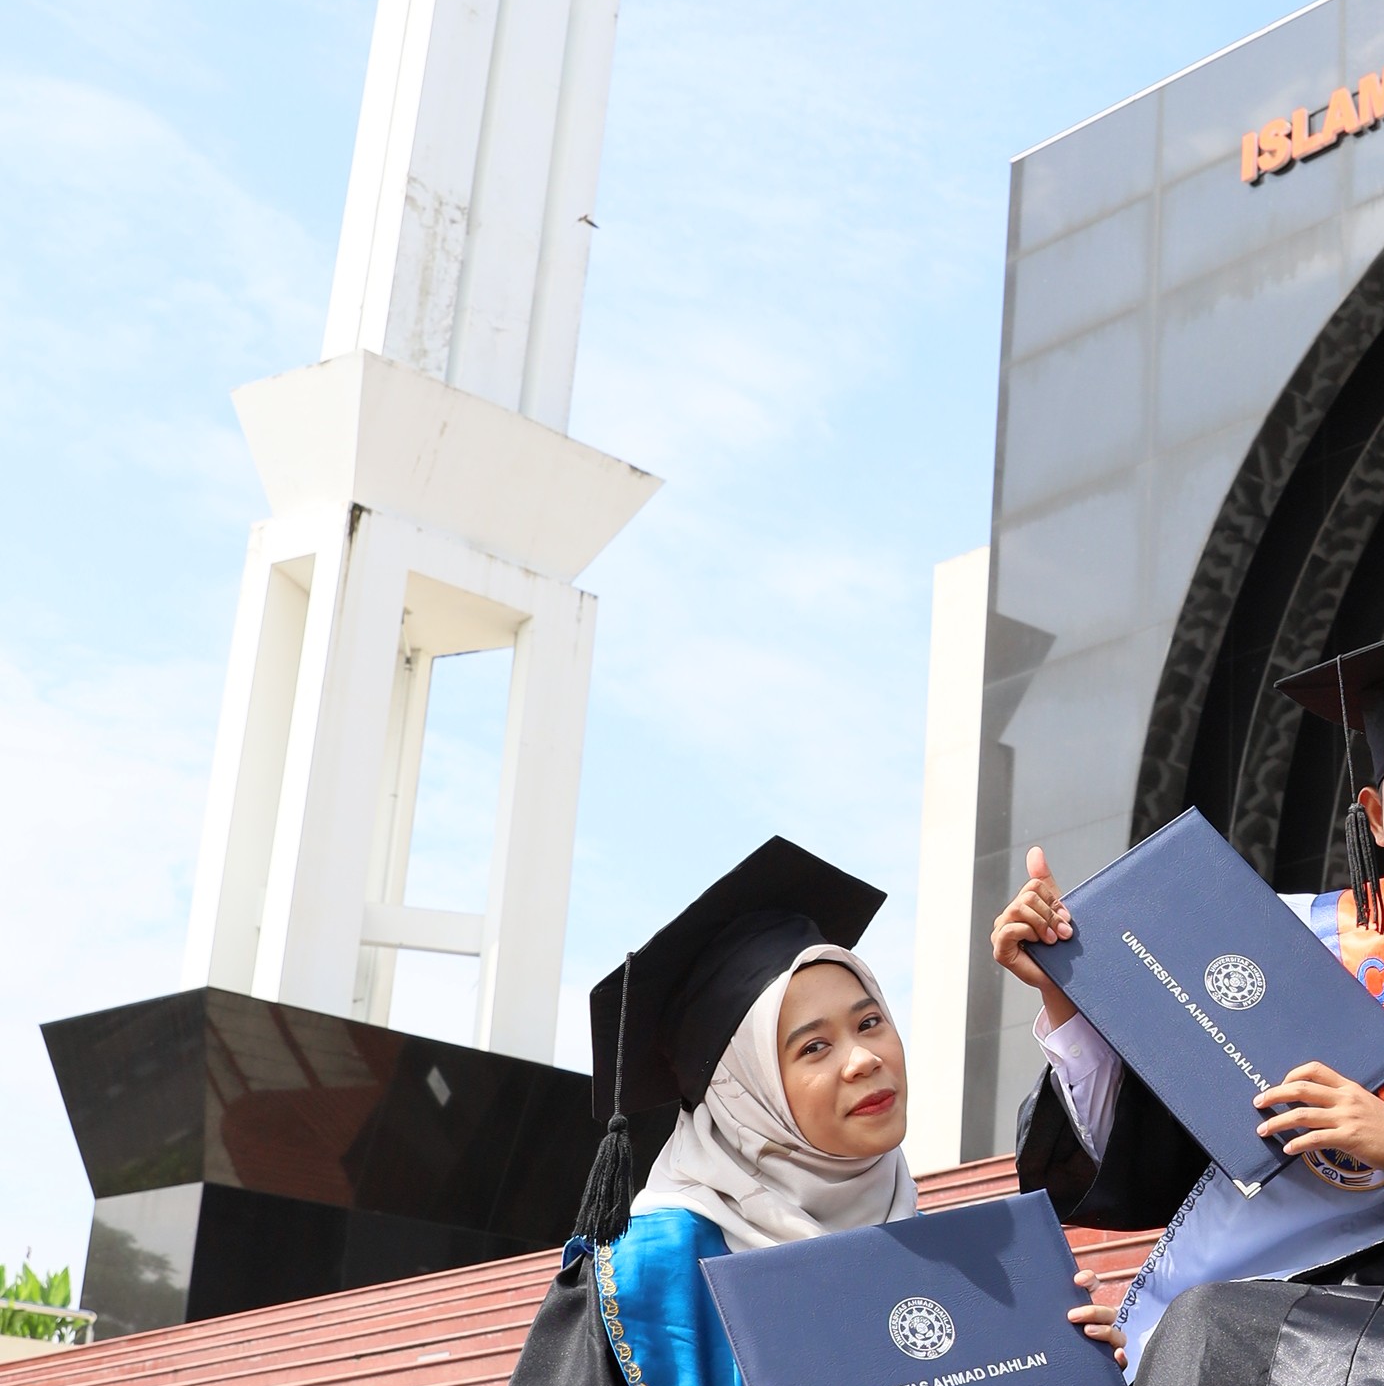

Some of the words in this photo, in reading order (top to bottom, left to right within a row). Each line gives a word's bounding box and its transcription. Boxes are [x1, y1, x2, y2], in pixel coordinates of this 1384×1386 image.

[1121, 931, 1190, 1004] UNIVERSITAS
[1184, 1003, 1227, 1044] AHMAD
[1223, 1042, 1271, 1092] DAHLAN
[986, 1352, 1048, 1377] DAHLAN
